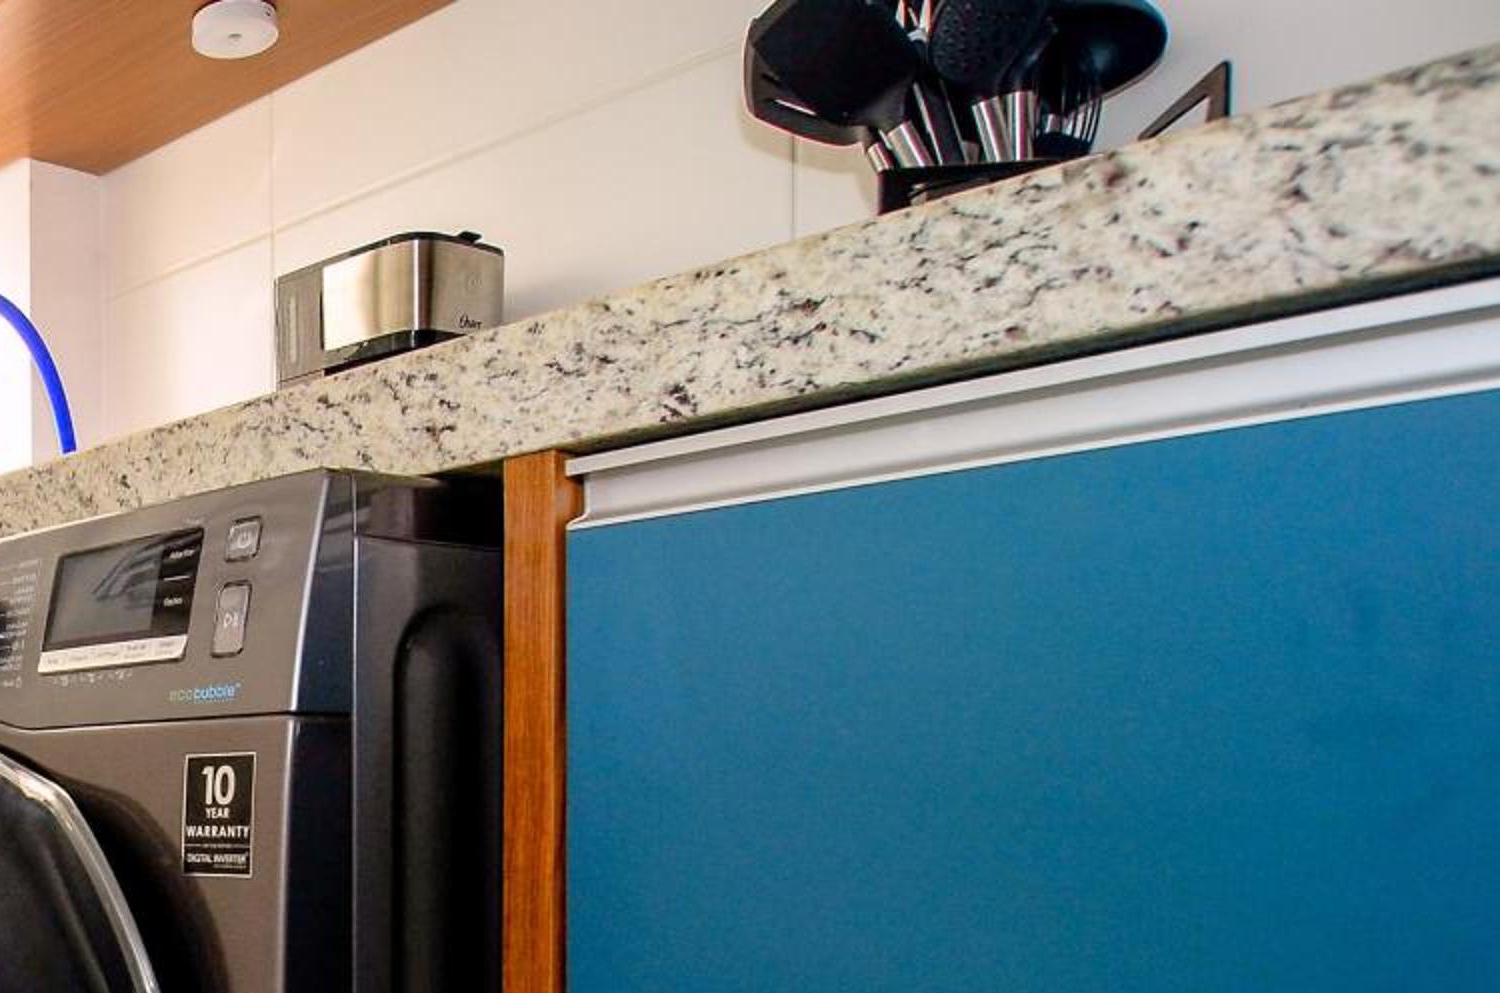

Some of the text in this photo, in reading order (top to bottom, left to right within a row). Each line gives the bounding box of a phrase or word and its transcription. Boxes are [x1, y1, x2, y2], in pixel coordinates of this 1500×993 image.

[202, 765, 236, 805] 10
[205, 807, 230, 819] YEAR
[186, 825, 250, 838] WARRANTY
